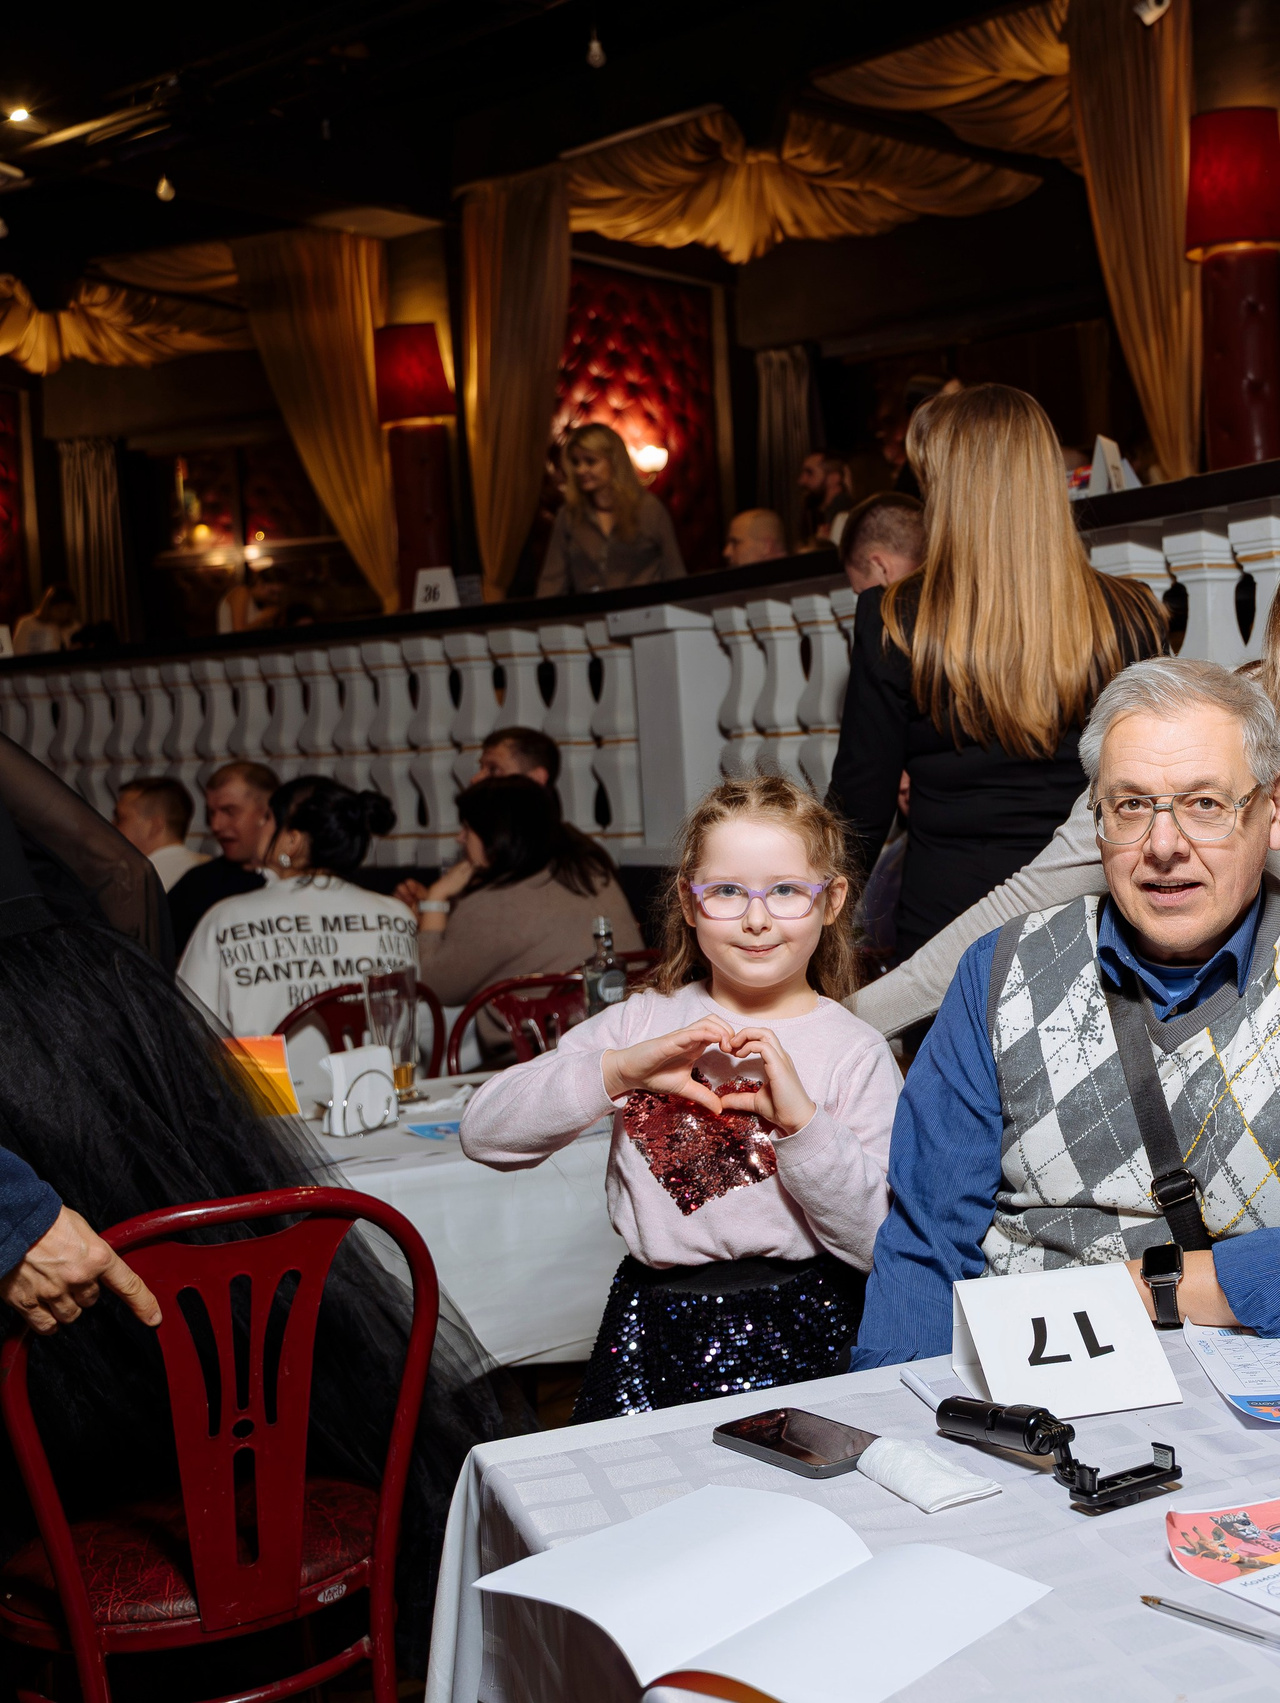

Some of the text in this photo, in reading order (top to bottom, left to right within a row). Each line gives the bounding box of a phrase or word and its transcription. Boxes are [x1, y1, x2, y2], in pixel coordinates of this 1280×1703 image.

[216, 914, 312, 945] VENICE
[220, 935, 339, 968] BOULEVARD
[235, 959, 326, 987] SANTA
[1028, 1310, 1115, 1366] 17
